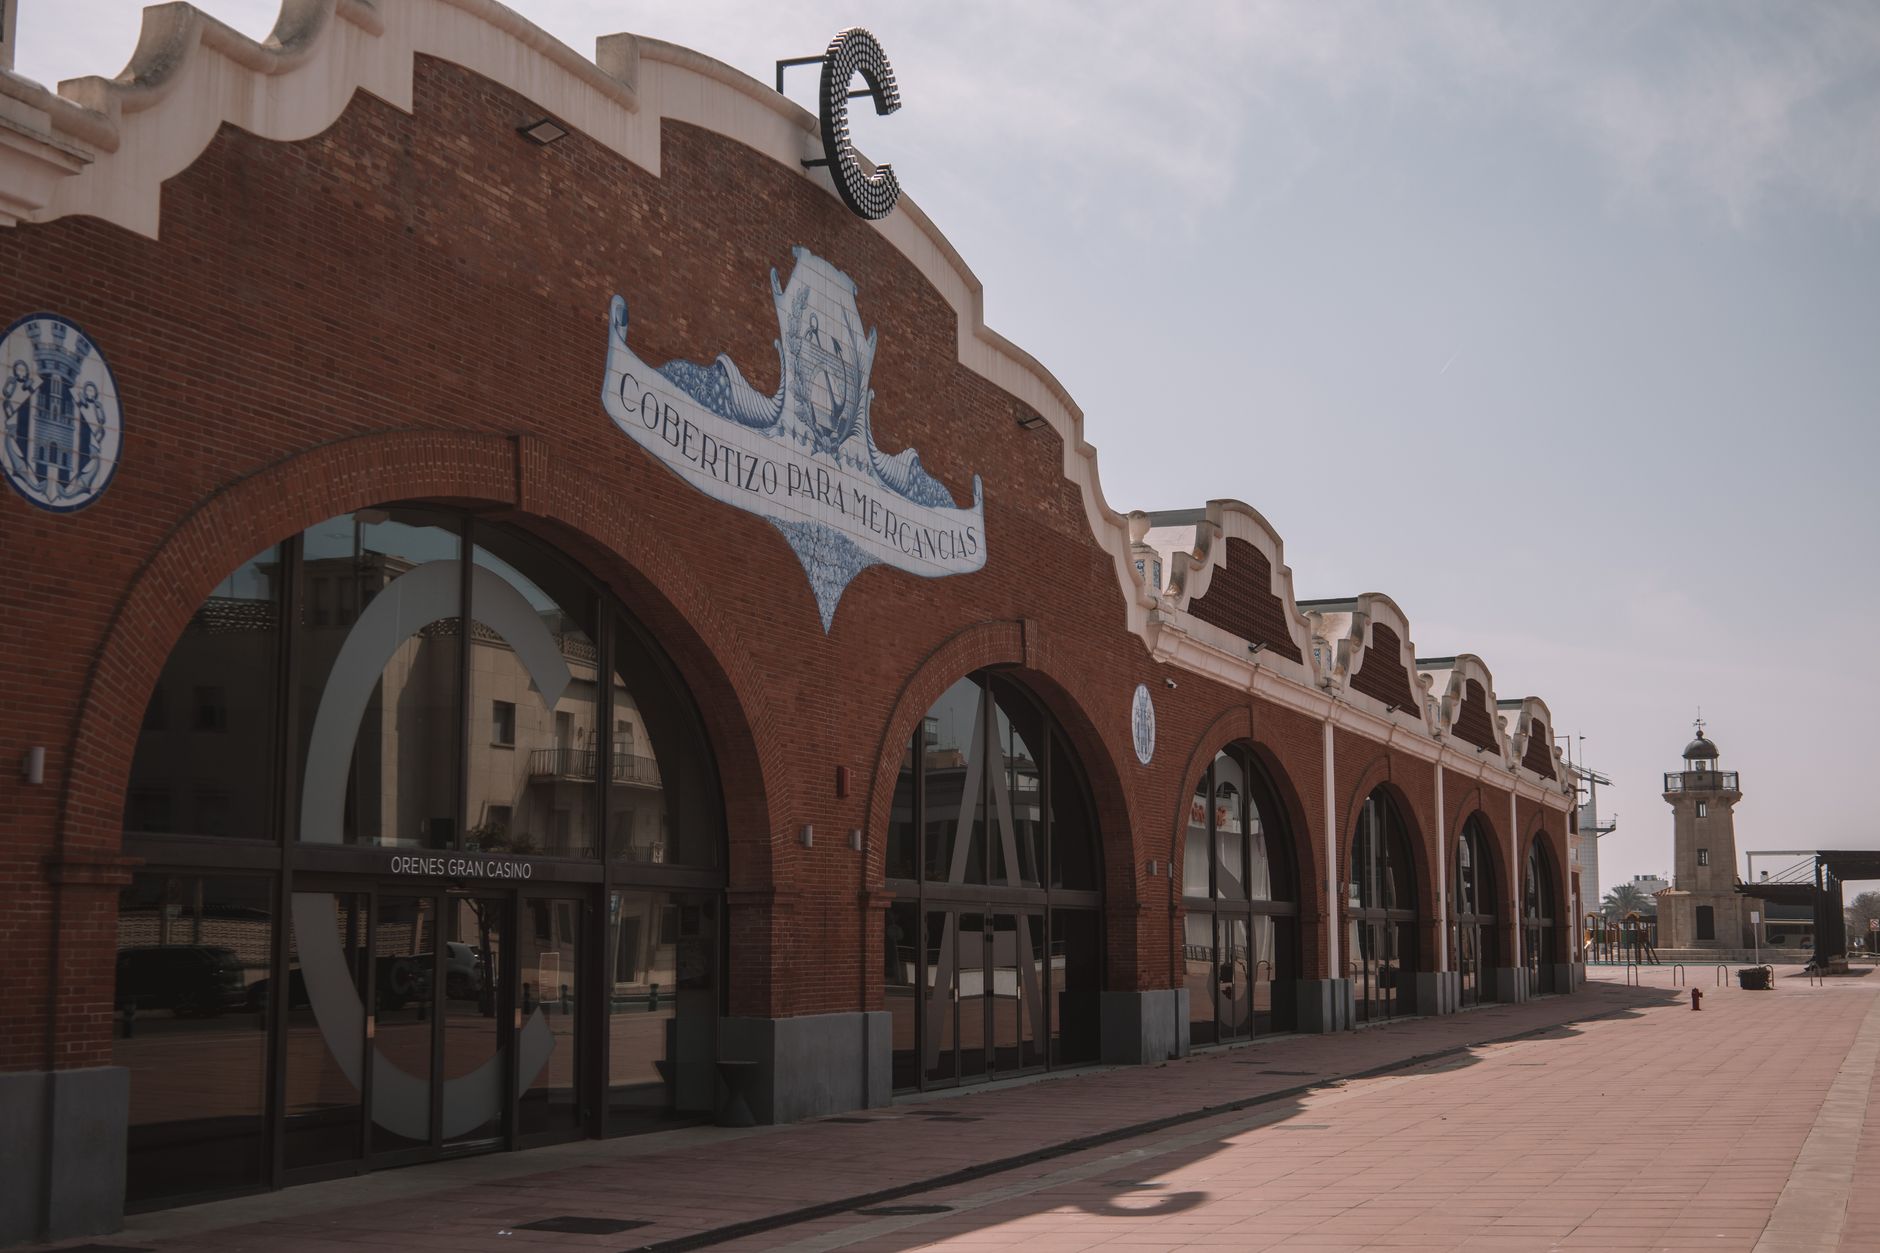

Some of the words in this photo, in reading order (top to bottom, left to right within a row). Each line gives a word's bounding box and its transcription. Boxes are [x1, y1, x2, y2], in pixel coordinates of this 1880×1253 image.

[819, 27, 902, 220] C
[620, 372, 778, 496] COBERTIZO
[787, 462, 846, 514] PARA
[853, 487, 978, 560] MERCANCIAS
[391, 856, 445, 875] ORENES
[448, 858, 484, 877] GRAN
[486, 862, 532, 879] CASINO
